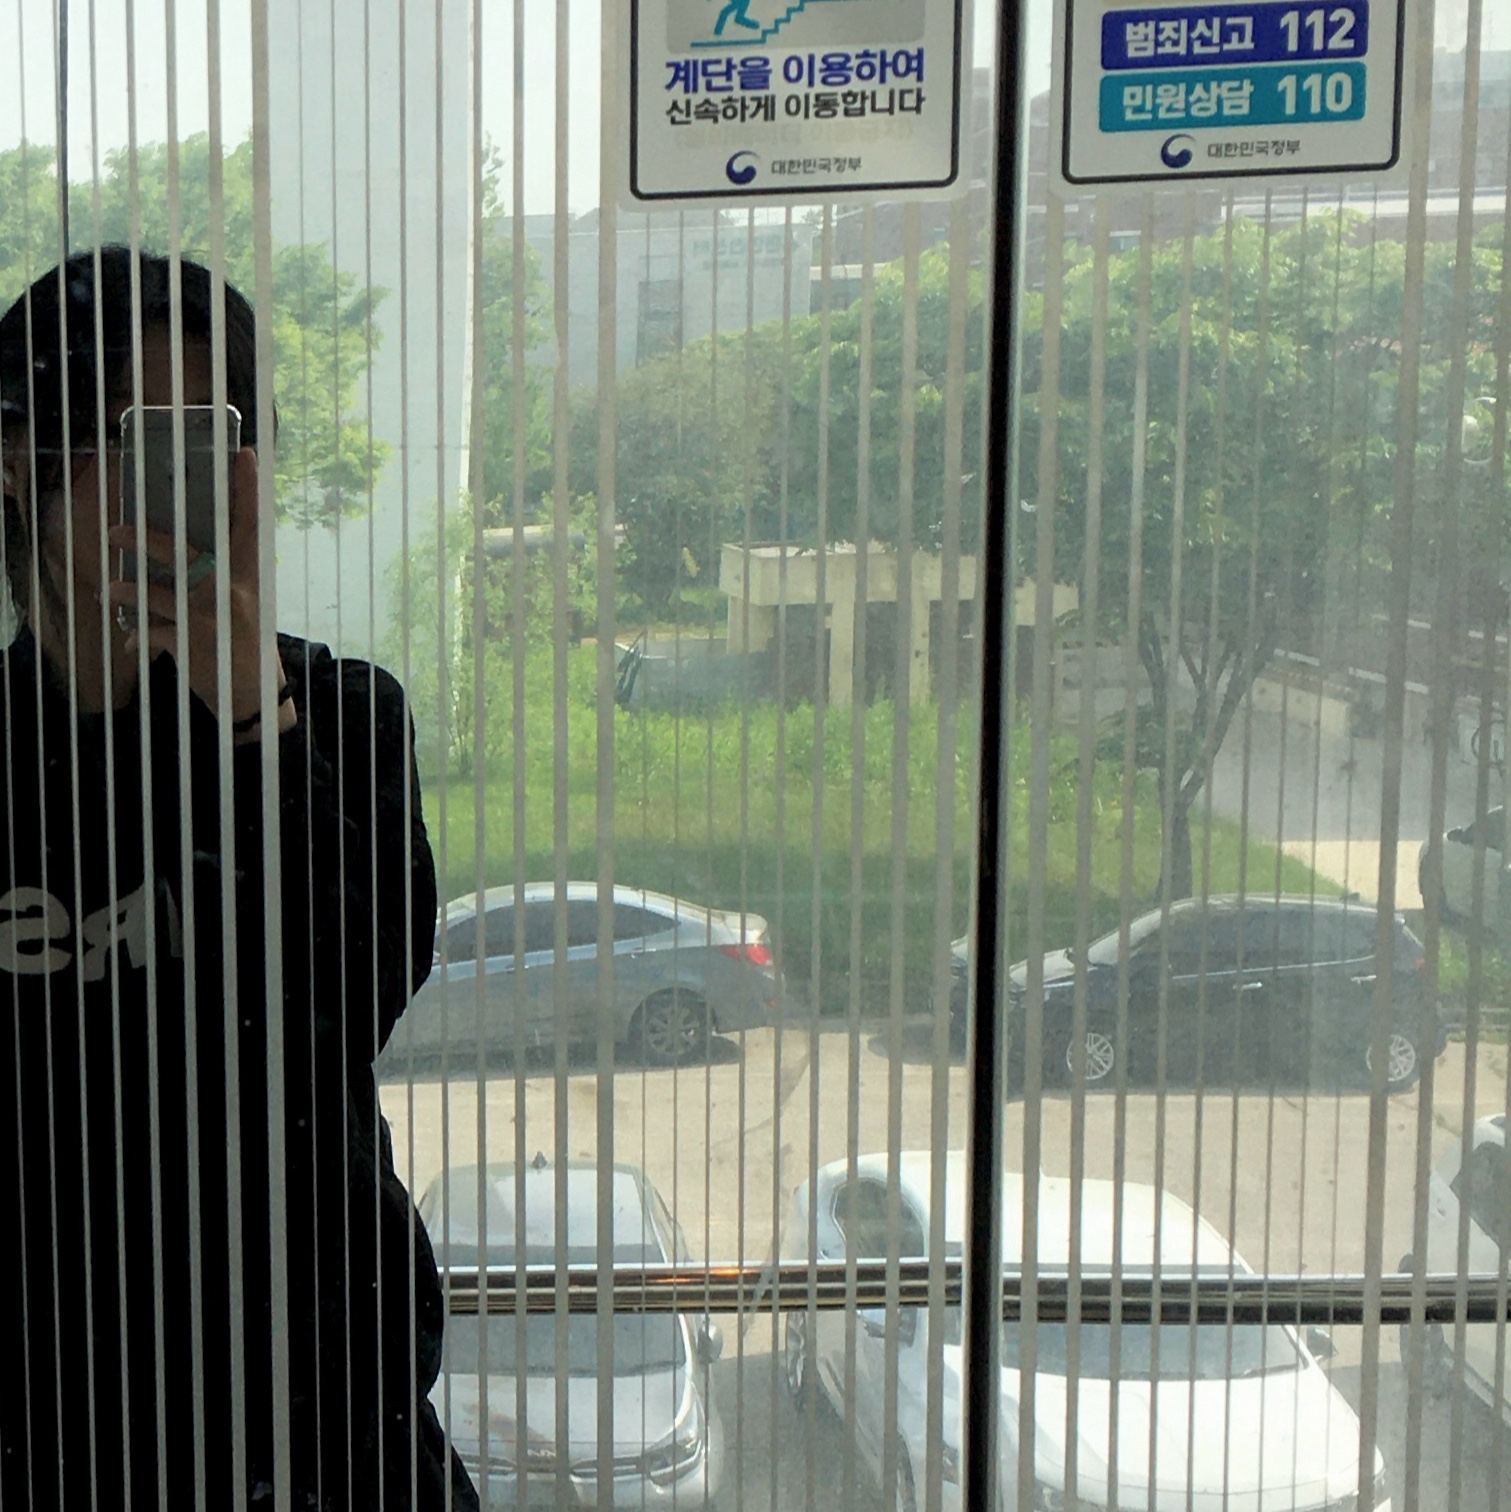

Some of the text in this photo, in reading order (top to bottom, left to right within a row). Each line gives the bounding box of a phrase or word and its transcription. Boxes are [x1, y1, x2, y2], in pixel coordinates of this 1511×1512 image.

[1125, 7, 1356, 59] 범죄신고 112
[665, 47, 926, 94] 계단을 이용하여
[666, 87, 927, 126] 신속하게 이동합니다
[1122, 71, 1354, 122] 민원상담 110
[771, 156, 863, 175] 대한민국정부
[1207, 139, 1301, 158] 대한민국정부
